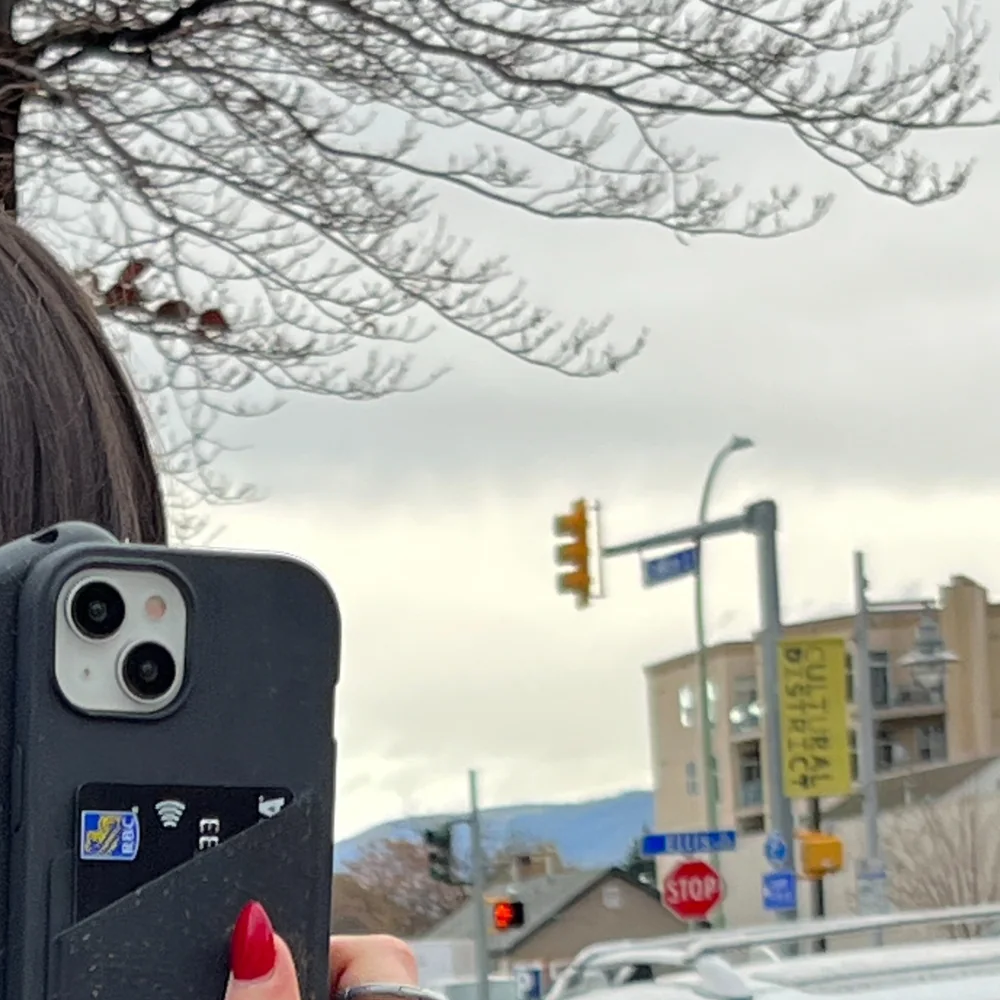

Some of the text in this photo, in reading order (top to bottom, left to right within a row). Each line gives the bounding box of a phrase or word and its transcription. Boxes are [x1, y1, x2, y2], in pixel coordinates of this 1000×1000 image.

[785, 648, 809, 788] DISTRICT
[805, 647, 834, 788] CULTURAL
[122, 816, 135, 855] RBC
[667, 875, 717, 904] STOP
